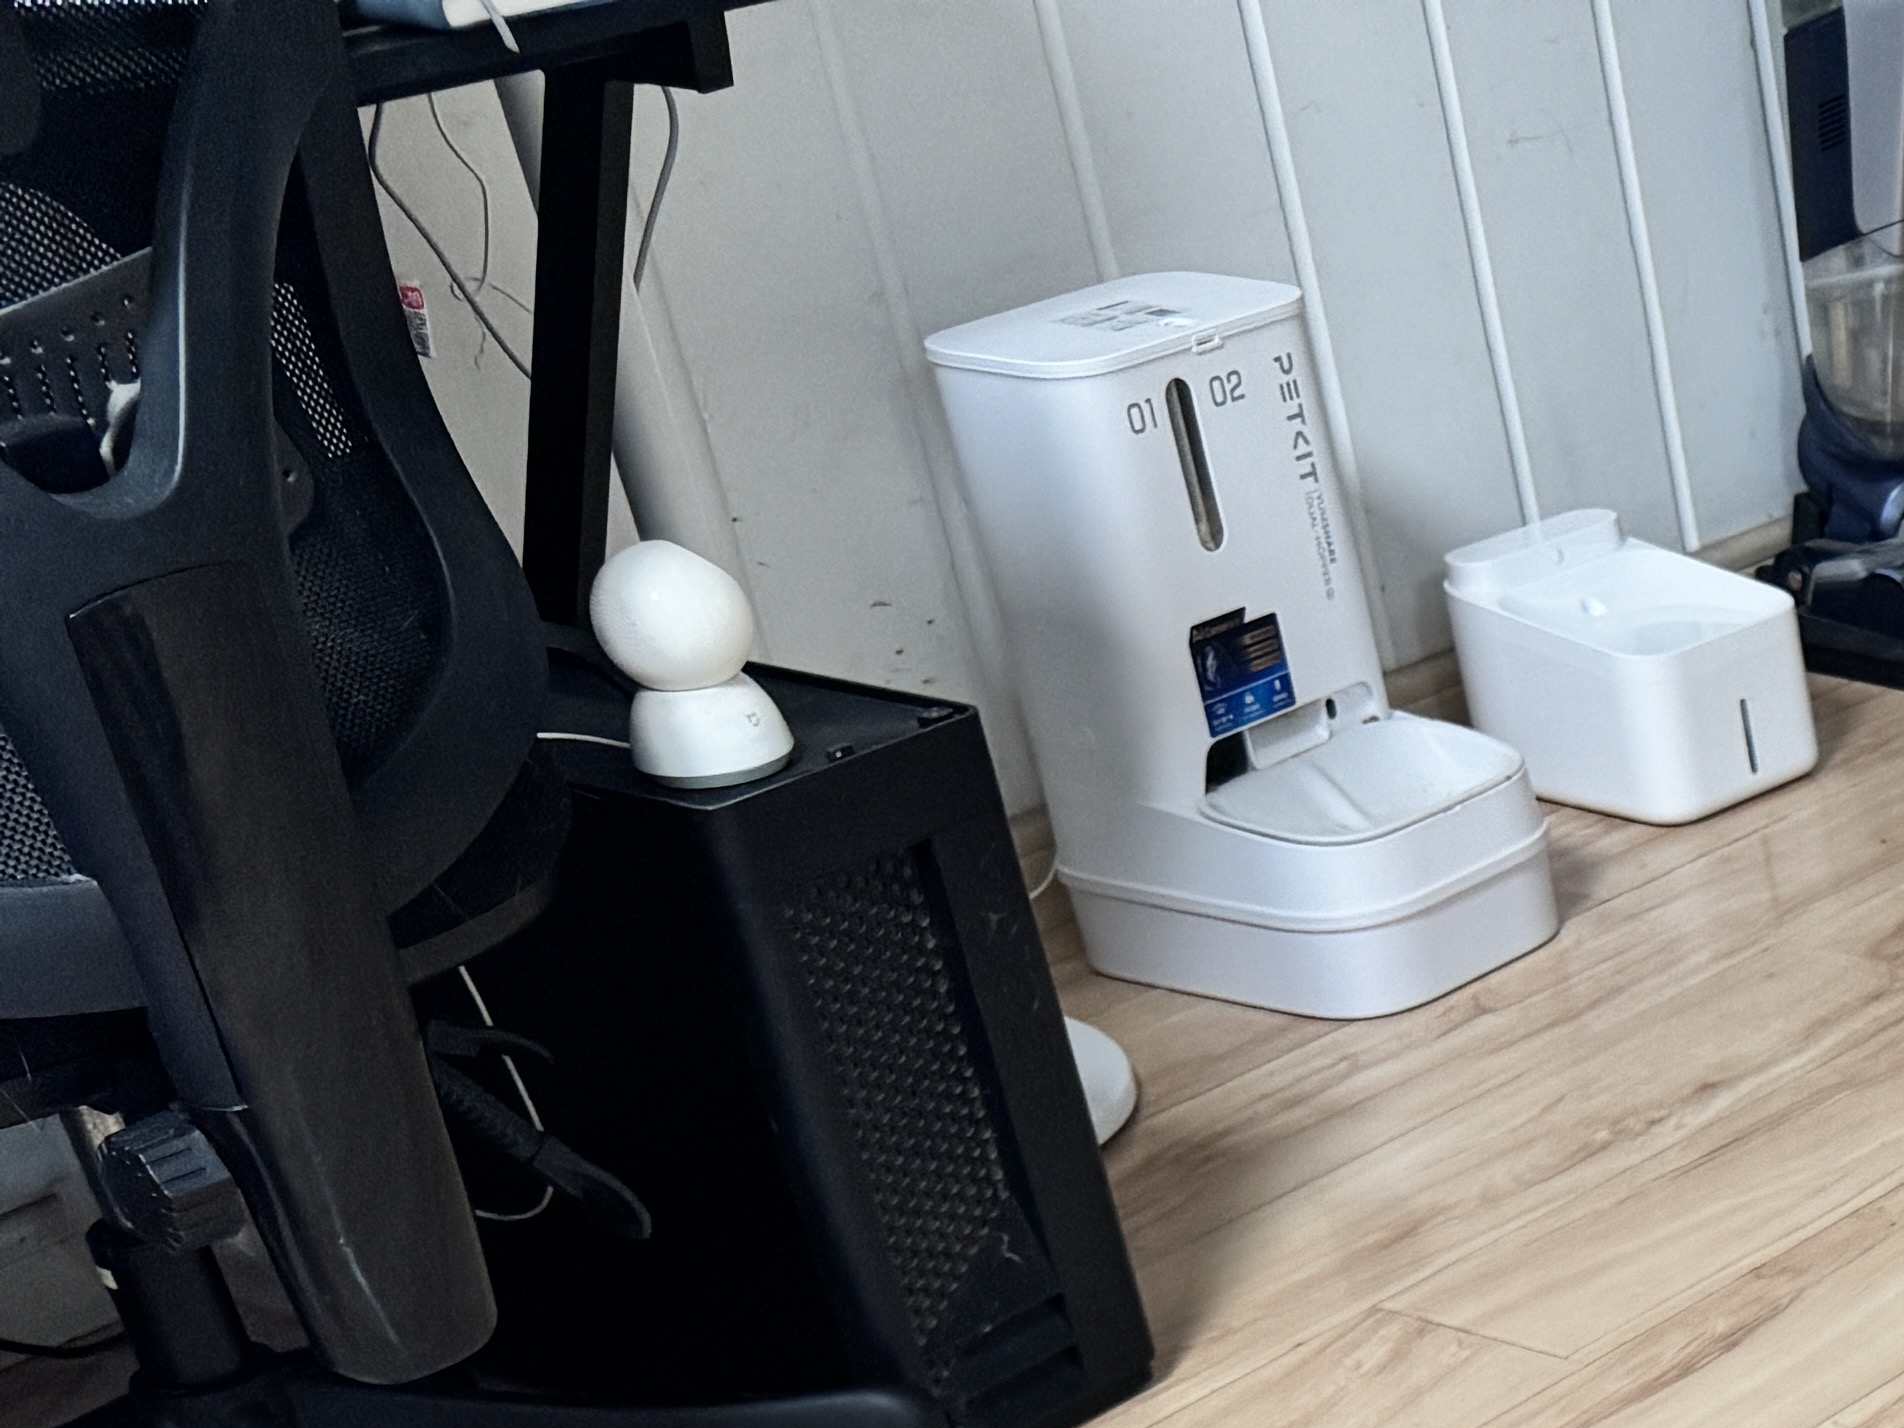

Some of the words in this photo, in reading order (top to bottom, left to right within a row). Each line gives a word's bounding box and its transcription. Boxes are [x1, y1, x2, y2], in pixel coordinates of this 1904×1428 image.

[1209, 369, 1245, 407] 02
[1126, 397, 1158, 435] 01
[1273, 352, 1319, 483] PETKIT
